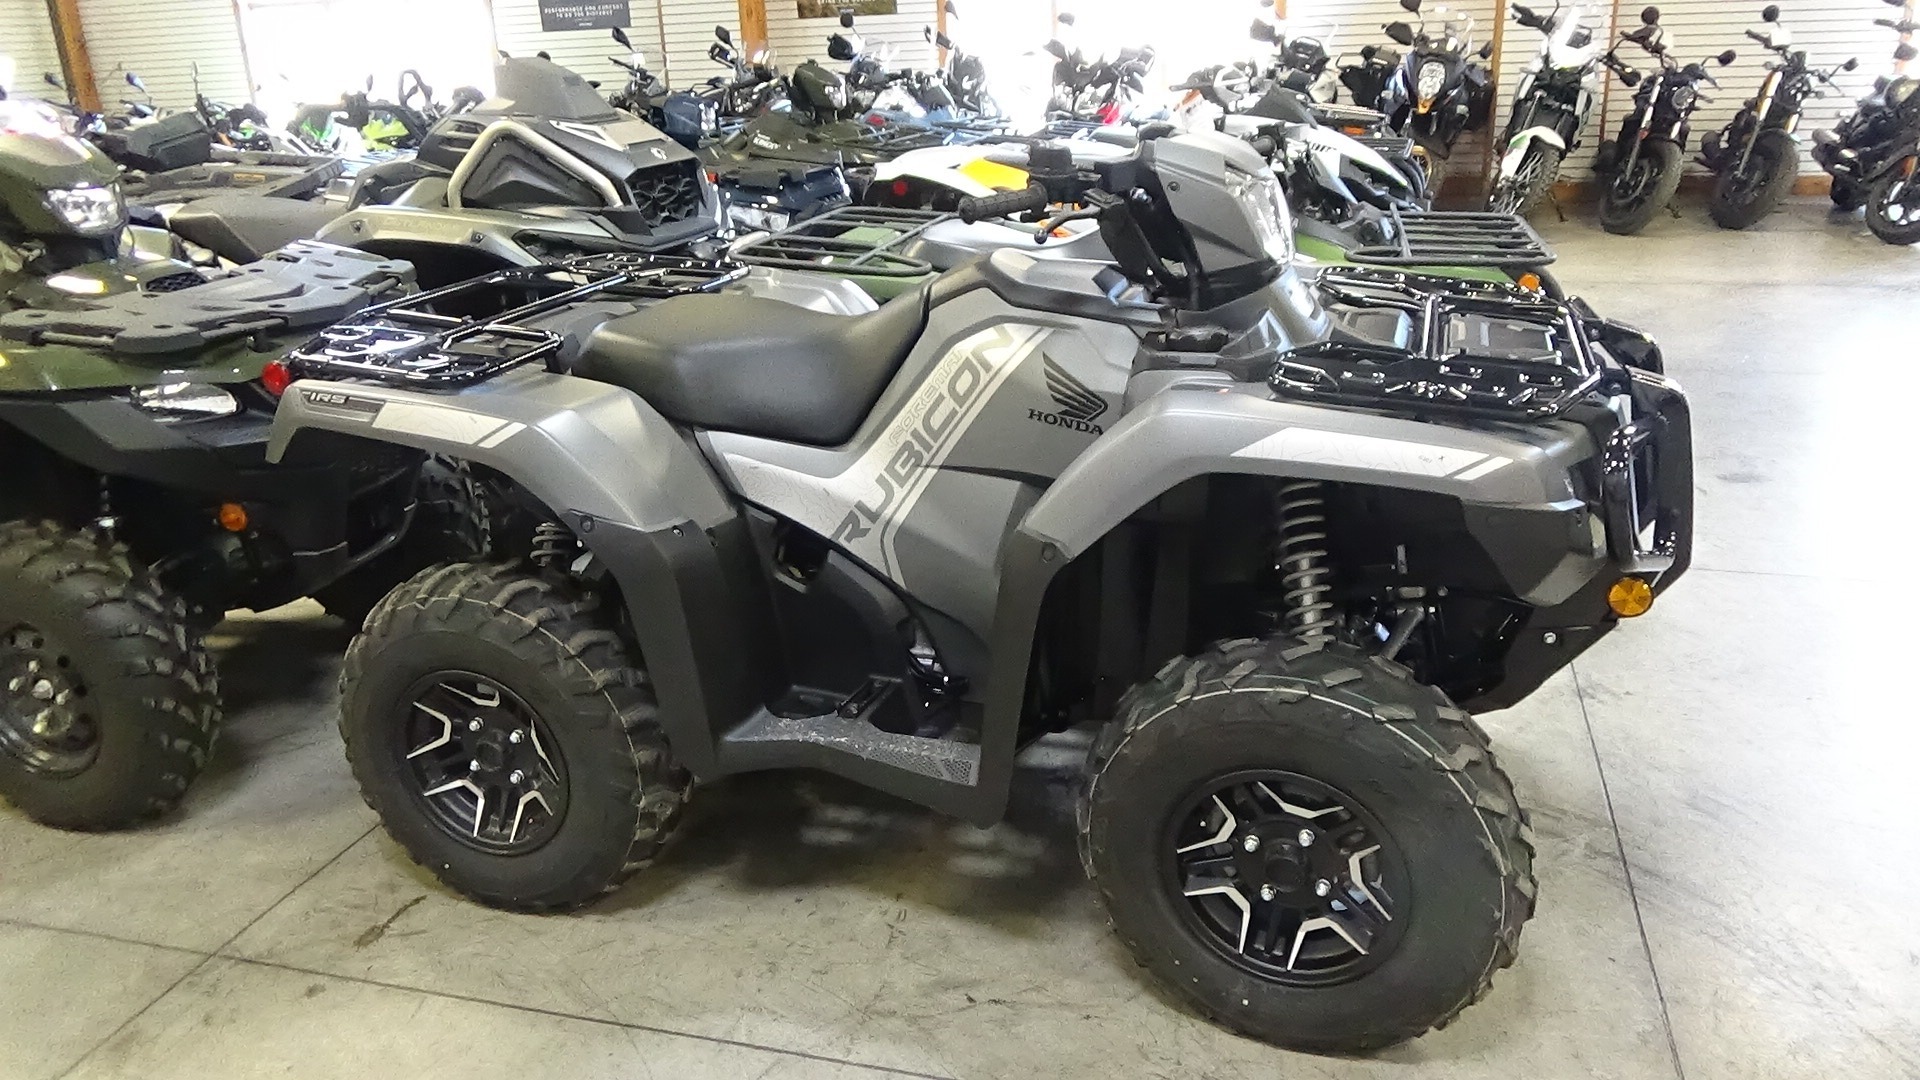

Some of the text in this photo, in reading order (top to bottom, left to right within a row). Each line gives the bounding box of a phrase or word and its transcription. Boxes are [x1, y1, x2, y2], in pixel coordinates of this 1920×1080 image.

[310, 391, 347, 403] IRS
[831, 325, 1015, 543] RUBICON
[1027, 408, 1104, 436] HONDA
